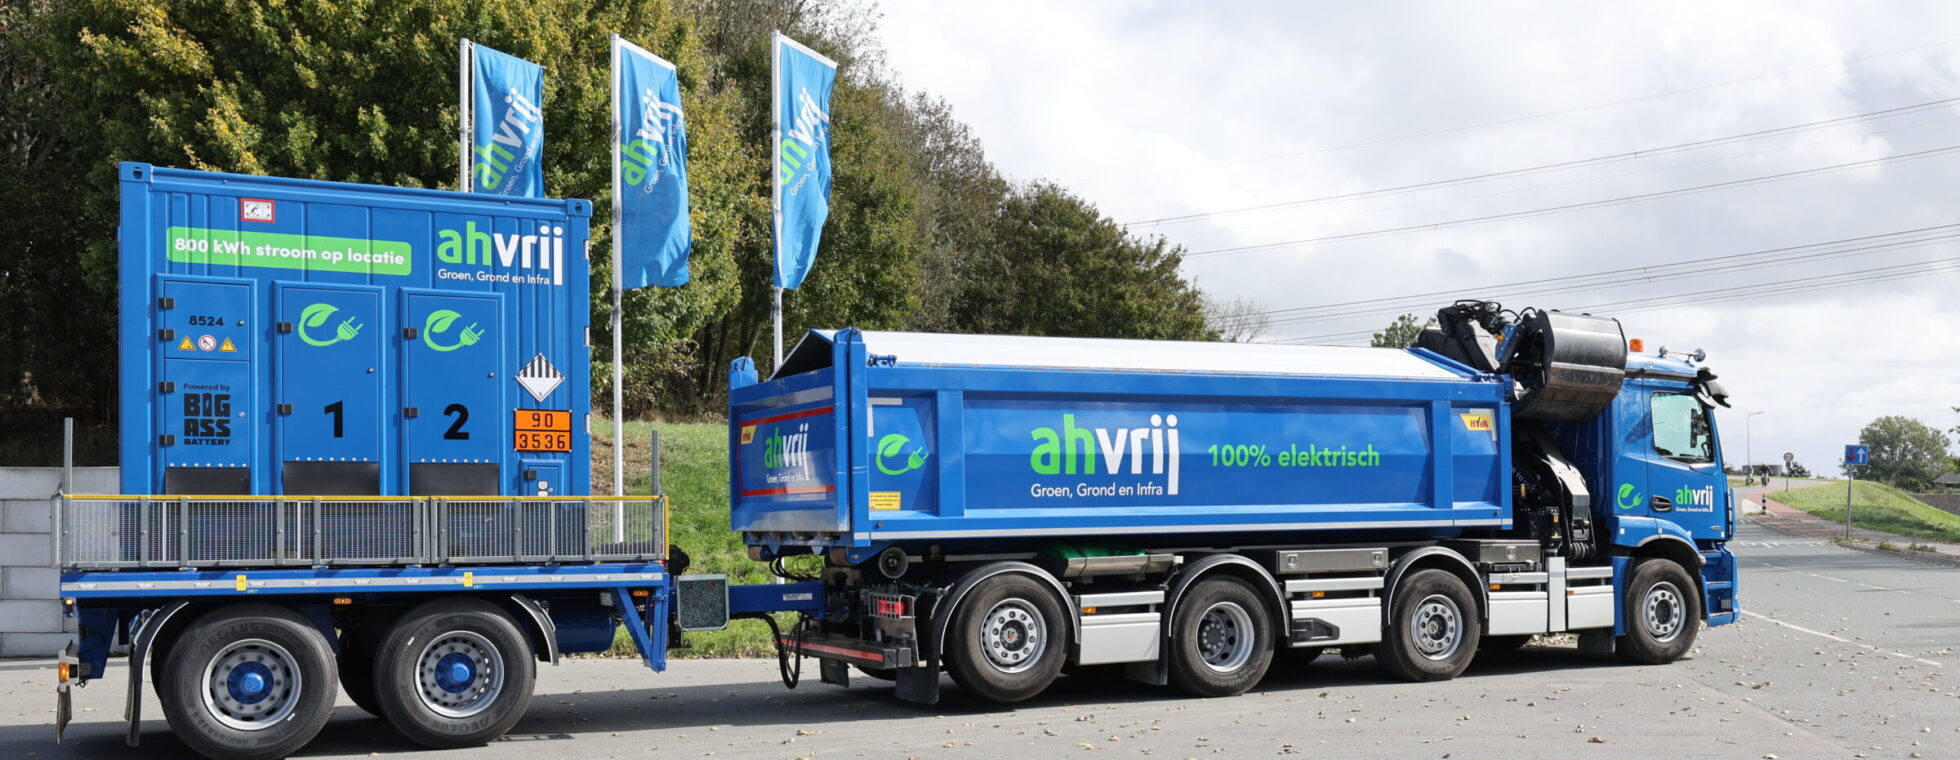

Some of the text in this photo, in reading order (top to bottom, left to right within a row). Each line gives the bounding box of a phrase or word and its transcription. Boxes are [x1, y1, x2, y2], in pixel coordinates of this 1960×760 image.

[474, 88, 543, 190] ahvrij
[175, 238, 404, 265] 800 kWh stroom op locatie
[437, 221, 563, 285] ahvrij
[438, 268, 550, 285] Groen, Grond en Infra
[189, 315, 224, 327] 8524
[183, 383, 230, 391] Powered by
[184, 392, 231, 417] BIG
[184, 418, 231, 437] ASS
[324, 400, 343, 438] 1
[443, 403, 469, 440] 2
[531, 413, 553, 428] 90
[184, 438, 231, 446] BATTERY
[519, 433, 566, 449] 3536
[764, 422, 809, 481] ahvrij
[1030, 413, 1180, 495] ahvrij
[1208, 443, 1380, 467] 100% elektrisch
[1030, 481, 1163, 499] Groen, Grond en Infra
[1675, 484, 1713, 512] ahvrij
